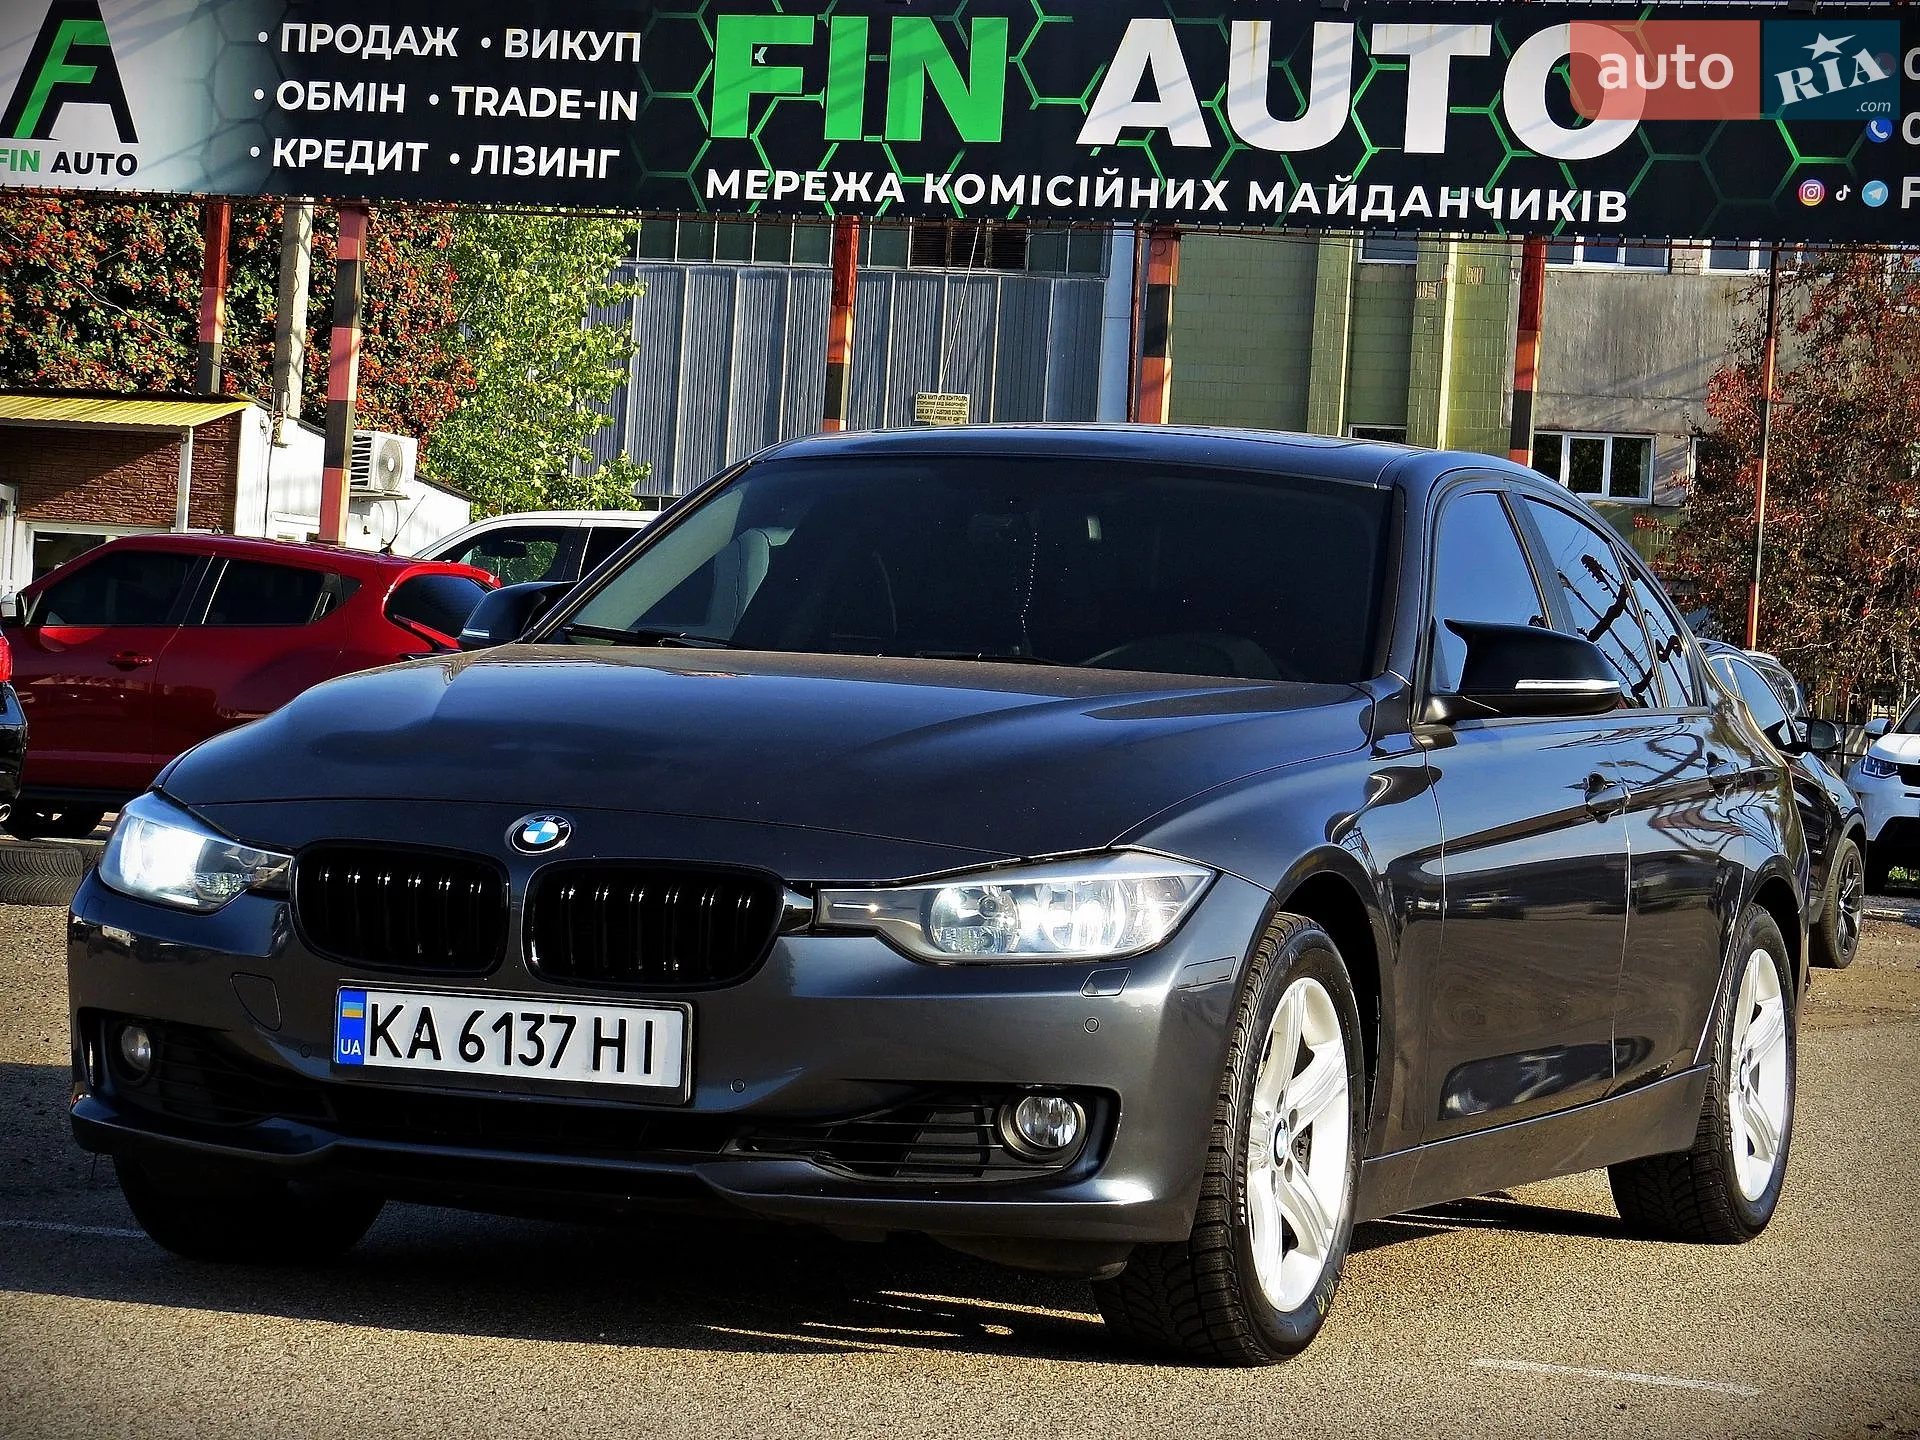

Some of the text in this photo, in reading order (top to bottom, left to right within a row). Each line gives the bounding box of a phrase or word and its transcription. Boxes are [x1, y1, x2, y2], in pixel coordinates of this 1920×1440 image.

[280, 22, 641, 63] ПРОДАЖ ВИКУП
[276, 80, 406, 114] ОБМІН
[451, 85, 638, 122] TRADE-IN
[711, 14, 1648, 160] FIN AUTO
[51, 151, 138, 177] AUTO
[272, 138, 621, 179] КРЕДИТ ЛІЗИНГ
[705, 167, 1628, 224] МЕРЕЖА КОМІСІЙНИХ МАЙДАНЧИКІВ
[340, 1038, 362, 1056] UA
[368, 1002, 655, 1075] KA 6137 HI
